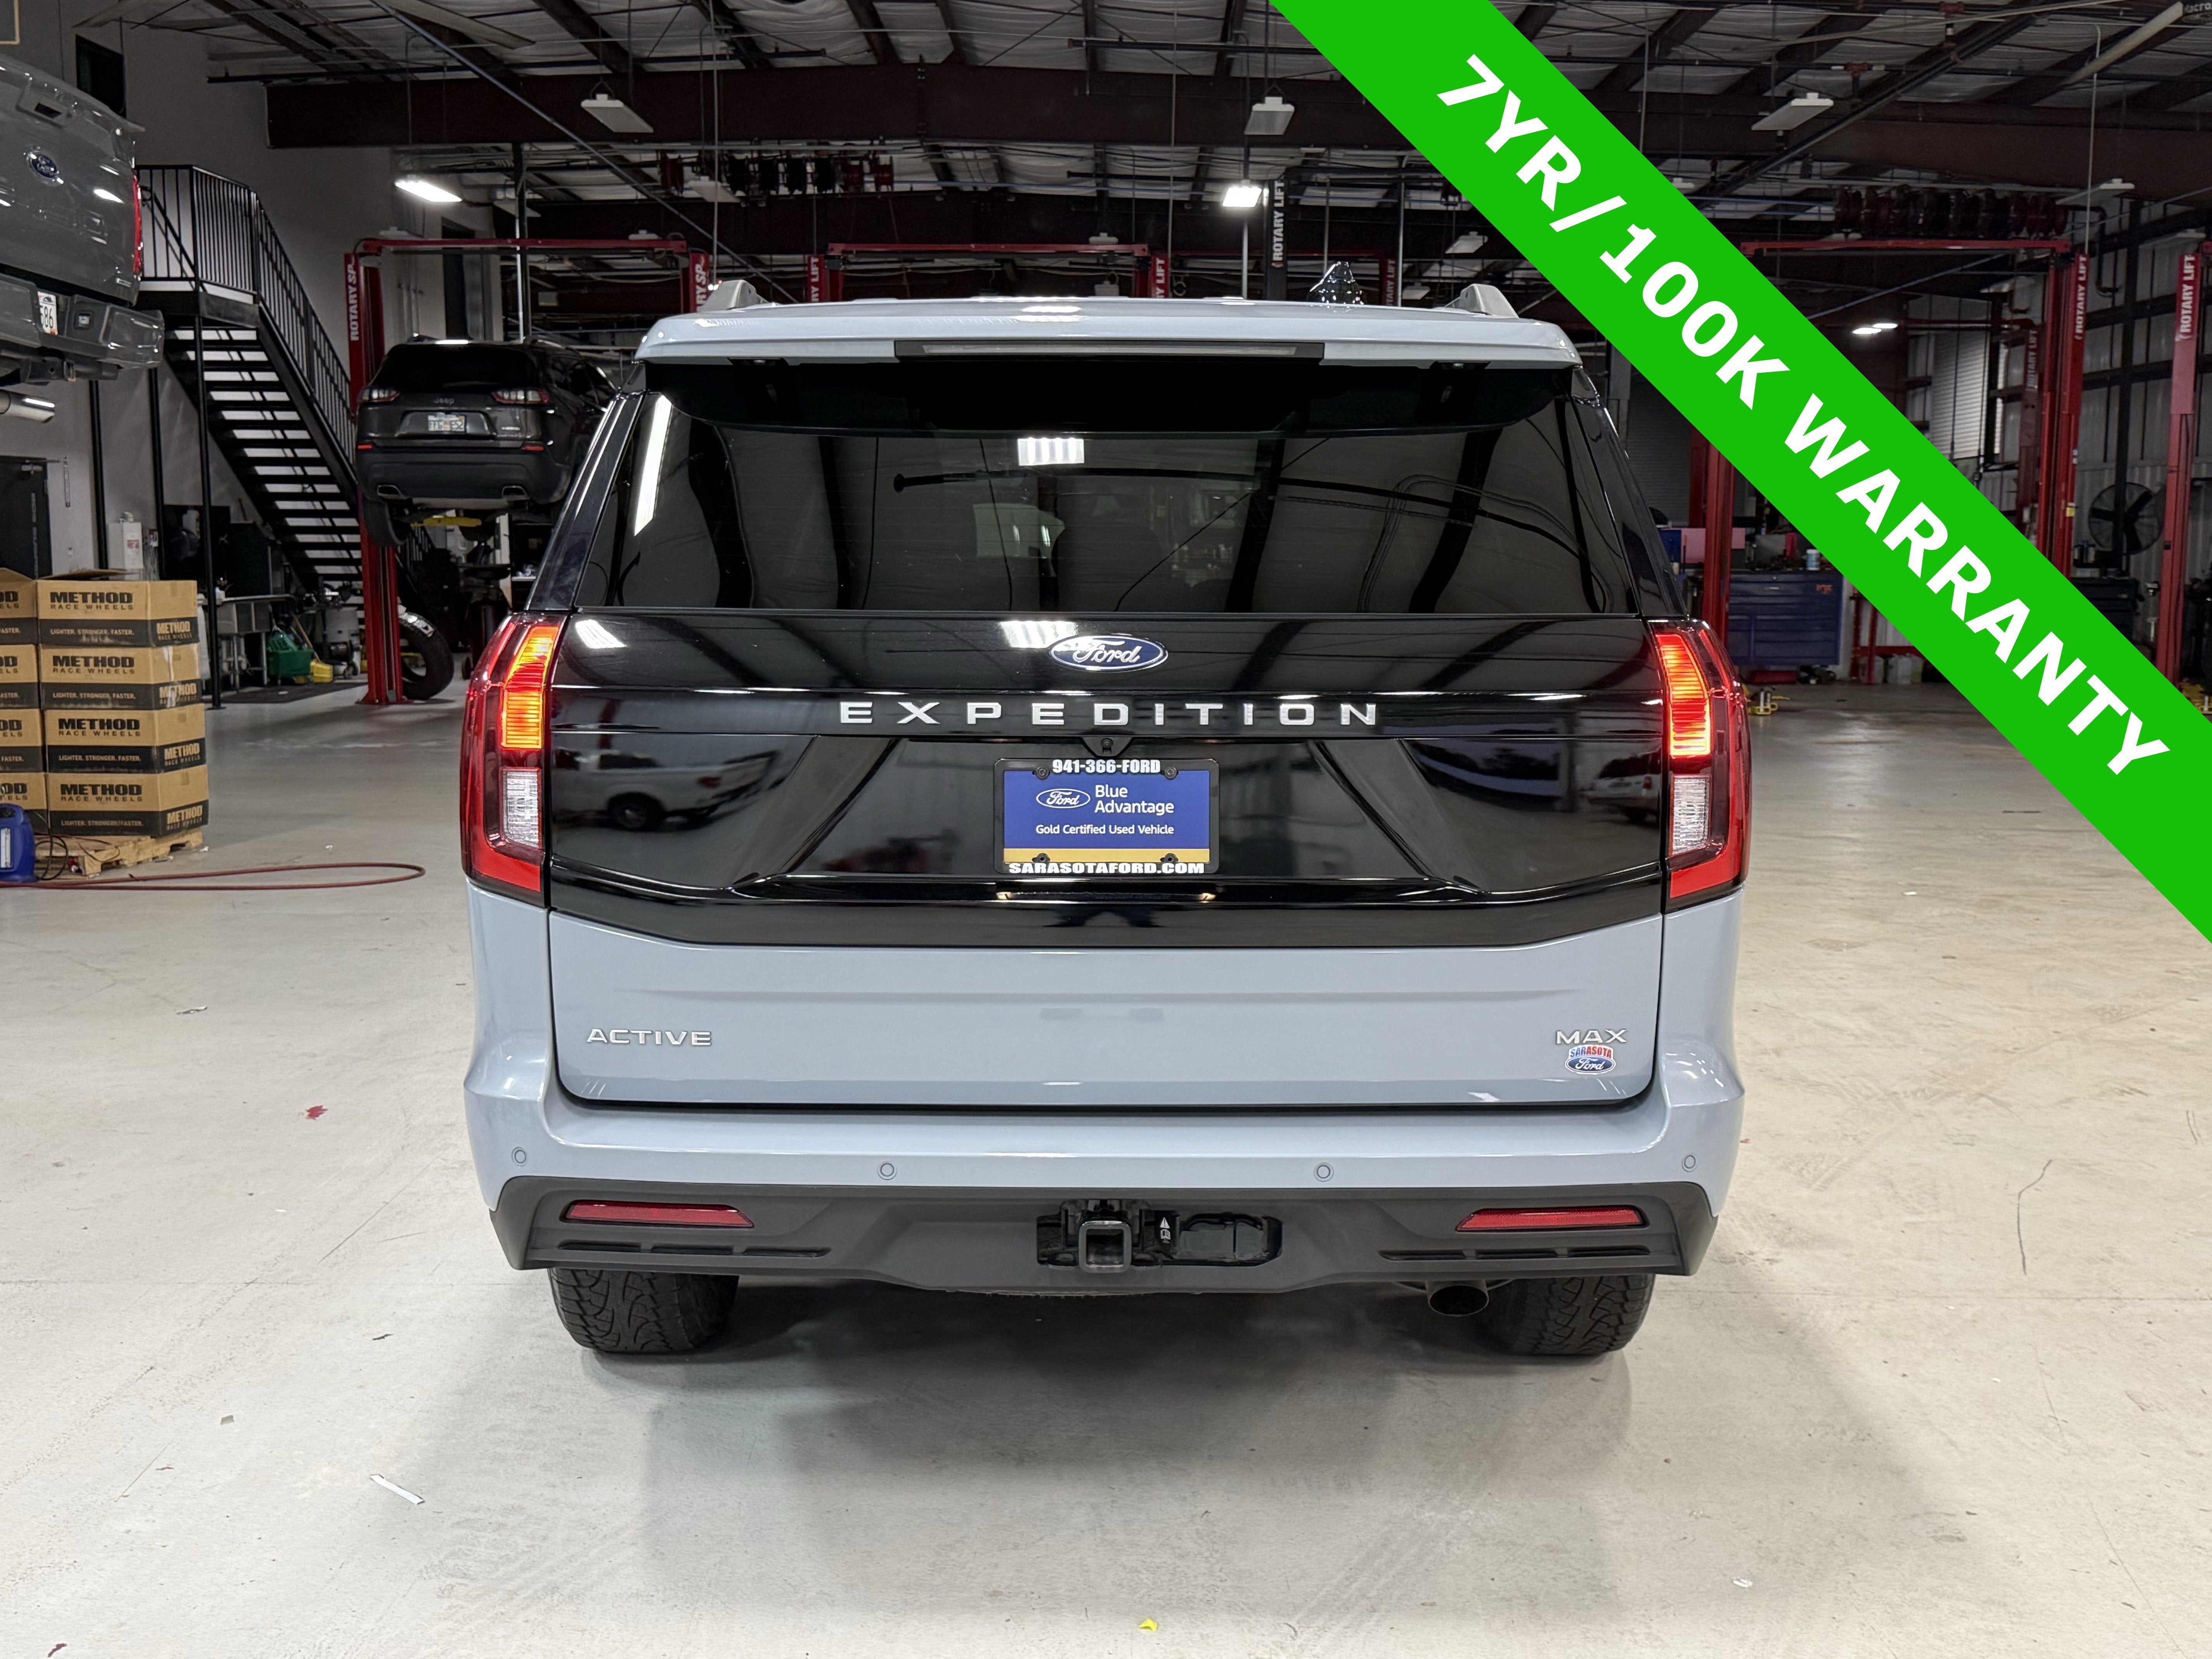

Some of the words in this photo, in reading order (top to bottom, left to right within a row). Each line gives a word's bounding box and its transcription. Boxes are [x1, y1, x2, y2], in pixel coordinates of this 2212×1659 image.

[1274, 180, 1285, 207] LIFT
[1273, 211, 1284, 261] ROTARY
[811, 256, 819, 282] LIFT
[1156, 257, 1165, 284] LIFT
[1387, 258, 1396, 278] LIFT
[2078, 255, 2087, 281] LIFT
[2183, 254, 2196, 281] LIFT
[1386, 280, 1395, 306] TARY
[349, 284, 359, 341] ROTARY
[2075, 284, 2086, 334] ROTARY
[2179, 284, 2194, 333] ROTARY
[50, 592, 133, 604] METHOD
[156, 621, 191, 634] METHOD
[1072, 639, 1142, 663] Ford
[53, 655, 135, 668] METHOD
[840, 701, 1376, 726] EXPEDITION
[58, 718, 140, 730] METHOD
[164, 743, 200, 760] METHOD
[1052, 759, 1161, 773] 941-366-FORD
[60, 784, 143, 796] METHOD
[1095, 785, 1128, 798] Blue
[1046, 792, 1080, 806] Ford
[167, 805, 203, 824] METHOD
[1094, 800, 1175, 816] Advantage
[1036, 824, 1060, 835] Gold
[1062, 824, 1106, 835] Certified
[1108, 824, 1135, 835] Used
[1137, 824, 1175, 835] Vehicle
[1008, 863, 1205, 874] SARASOTAFORD.COM
[587, 1028, 711, 1046] ACTIVE
[1556, 1029, 1627, 1044] MAX
[1570, 1046, 1612, 1059] SARASOTA
[1575, 1057, 1604, 1070] Ford
